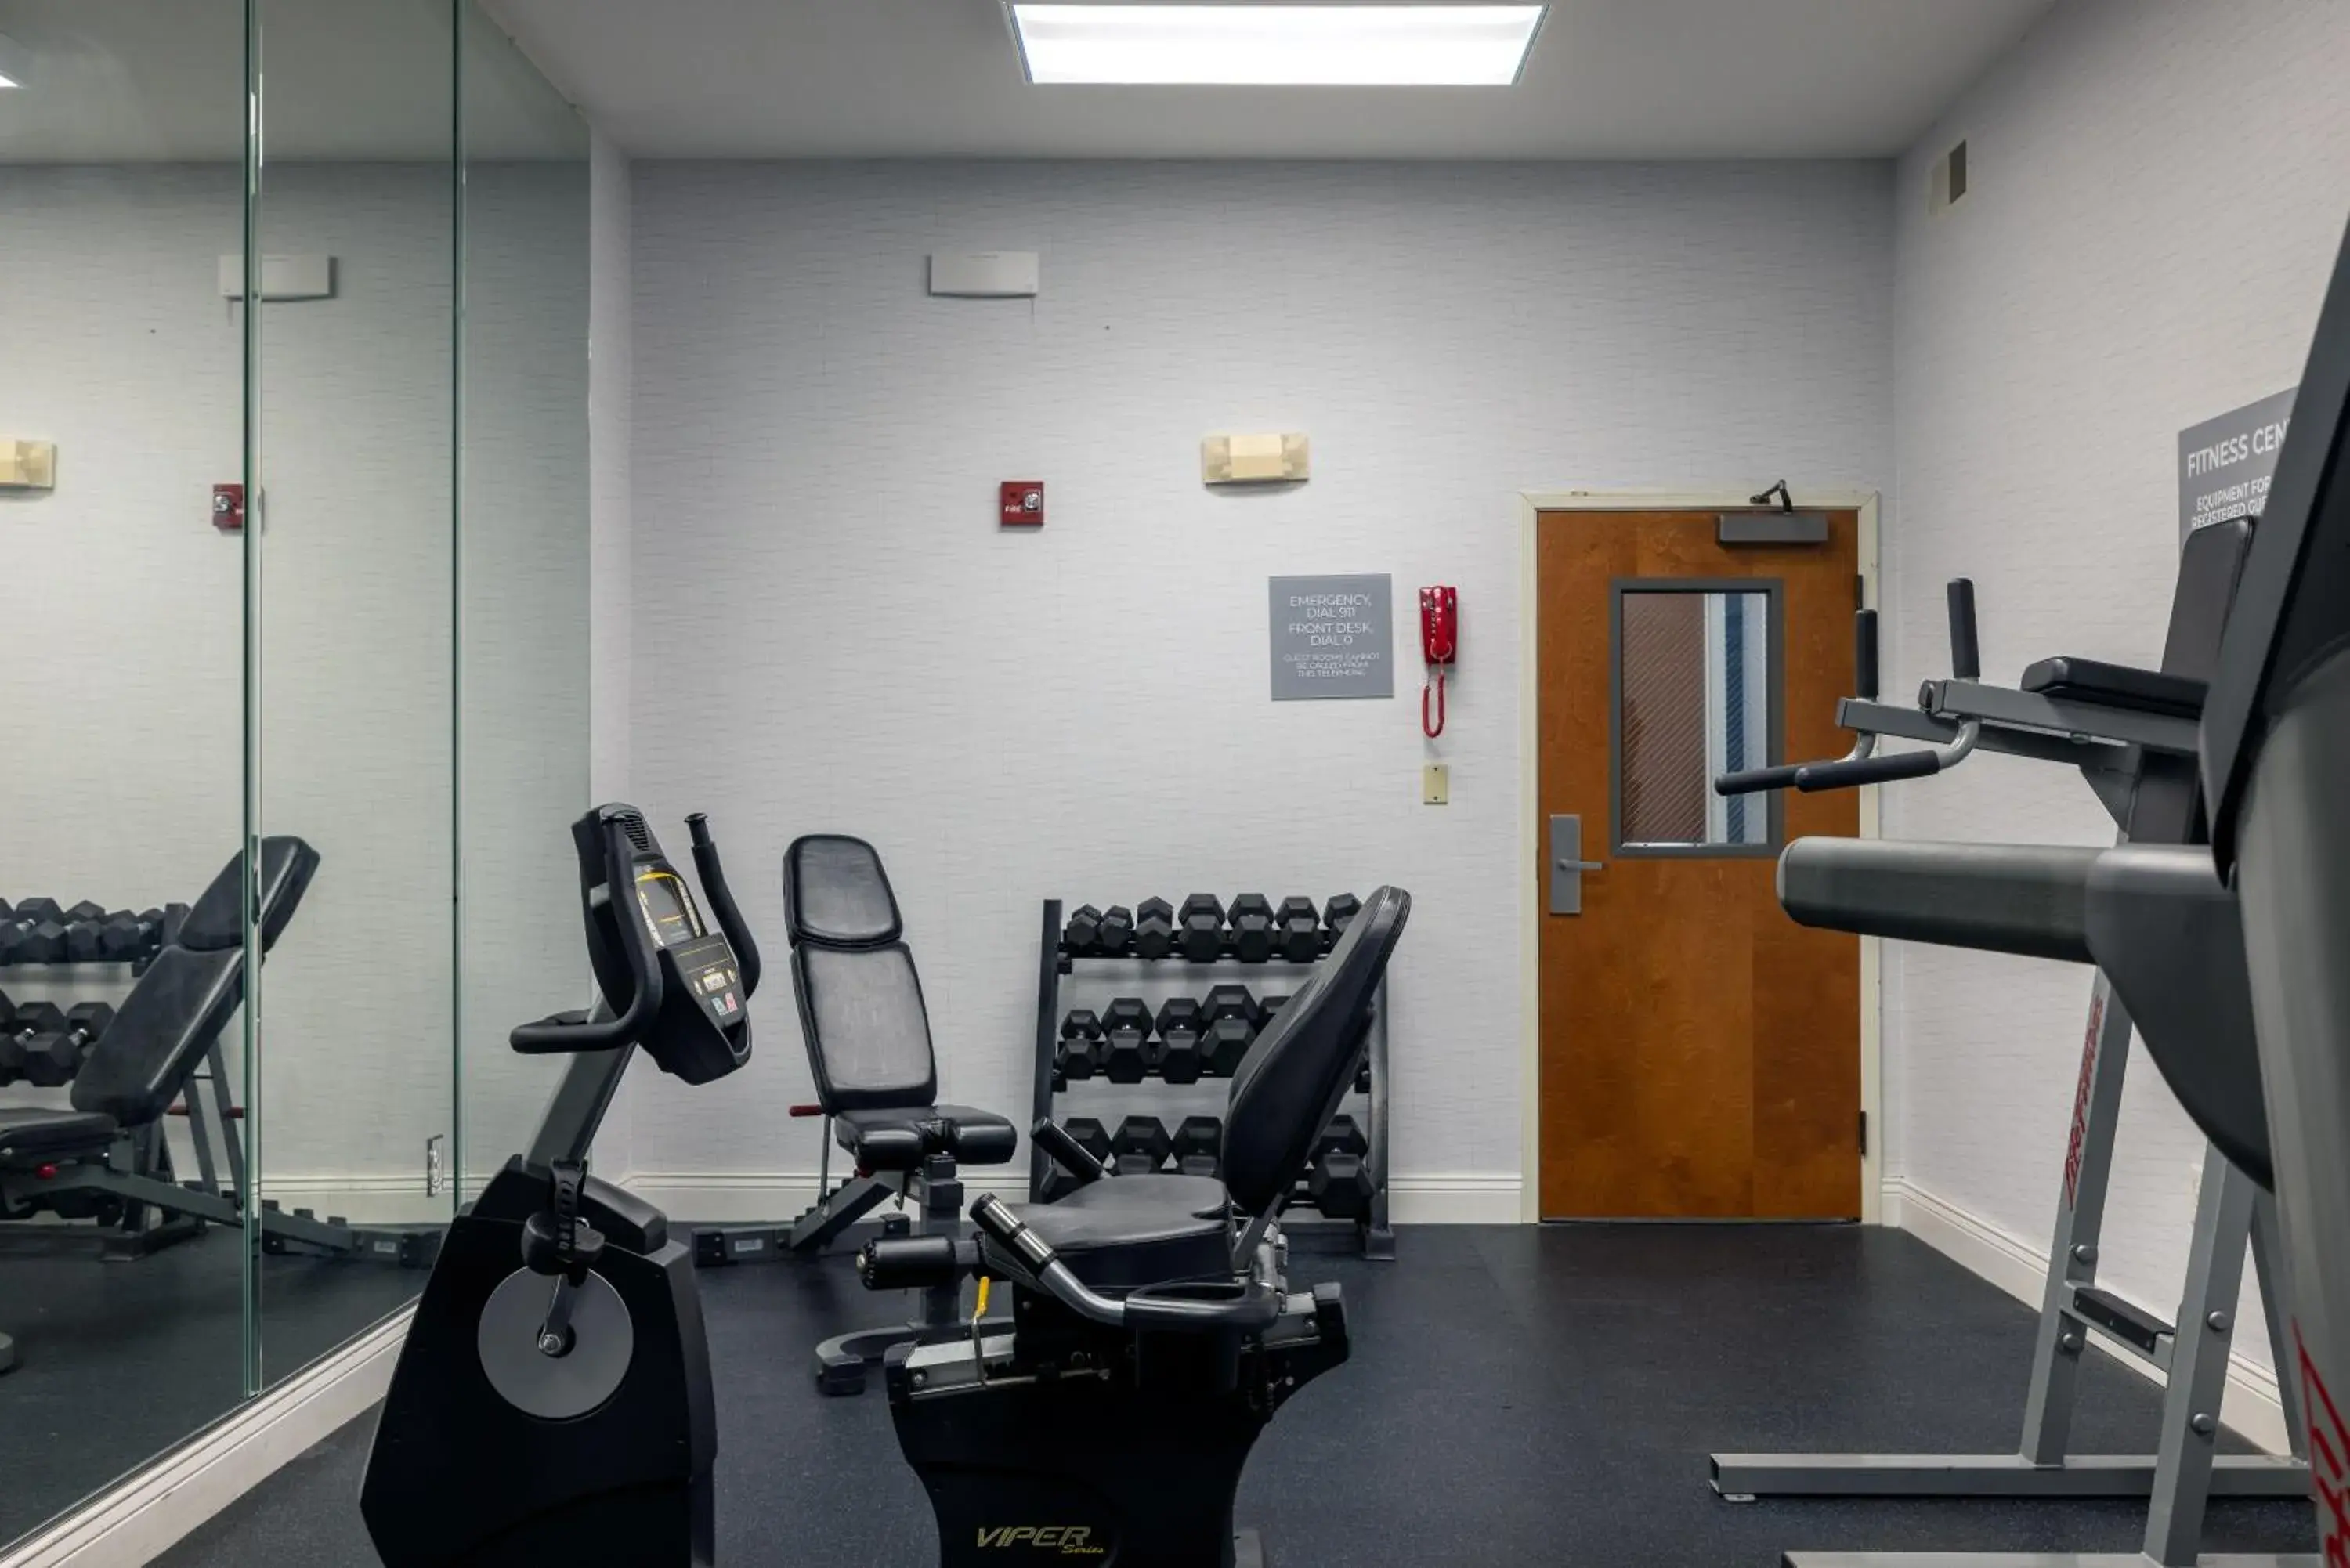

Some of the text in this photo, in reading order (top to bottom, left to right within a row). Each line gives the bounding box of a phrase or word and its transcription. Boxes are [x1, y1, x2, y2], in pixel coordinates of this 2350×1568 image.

[2188, 417, 2290, 478] FITNESS CEN
[2196, 475, 2272, 511] EQUIPMENT FOR
[2192, 502, 2246, 528] REGISTERED
[1290, 594, 1372, 607] EMERGENCY,
[1307, 607, 1355, 618] DIAL 911
[1289, 623, 1333, 634] FRONT
[1311, 635, 1343, 646] DIAL
[978, 1526, 1091, 1548] VIPER
[1061, 1544, 1104, 1554] Series
